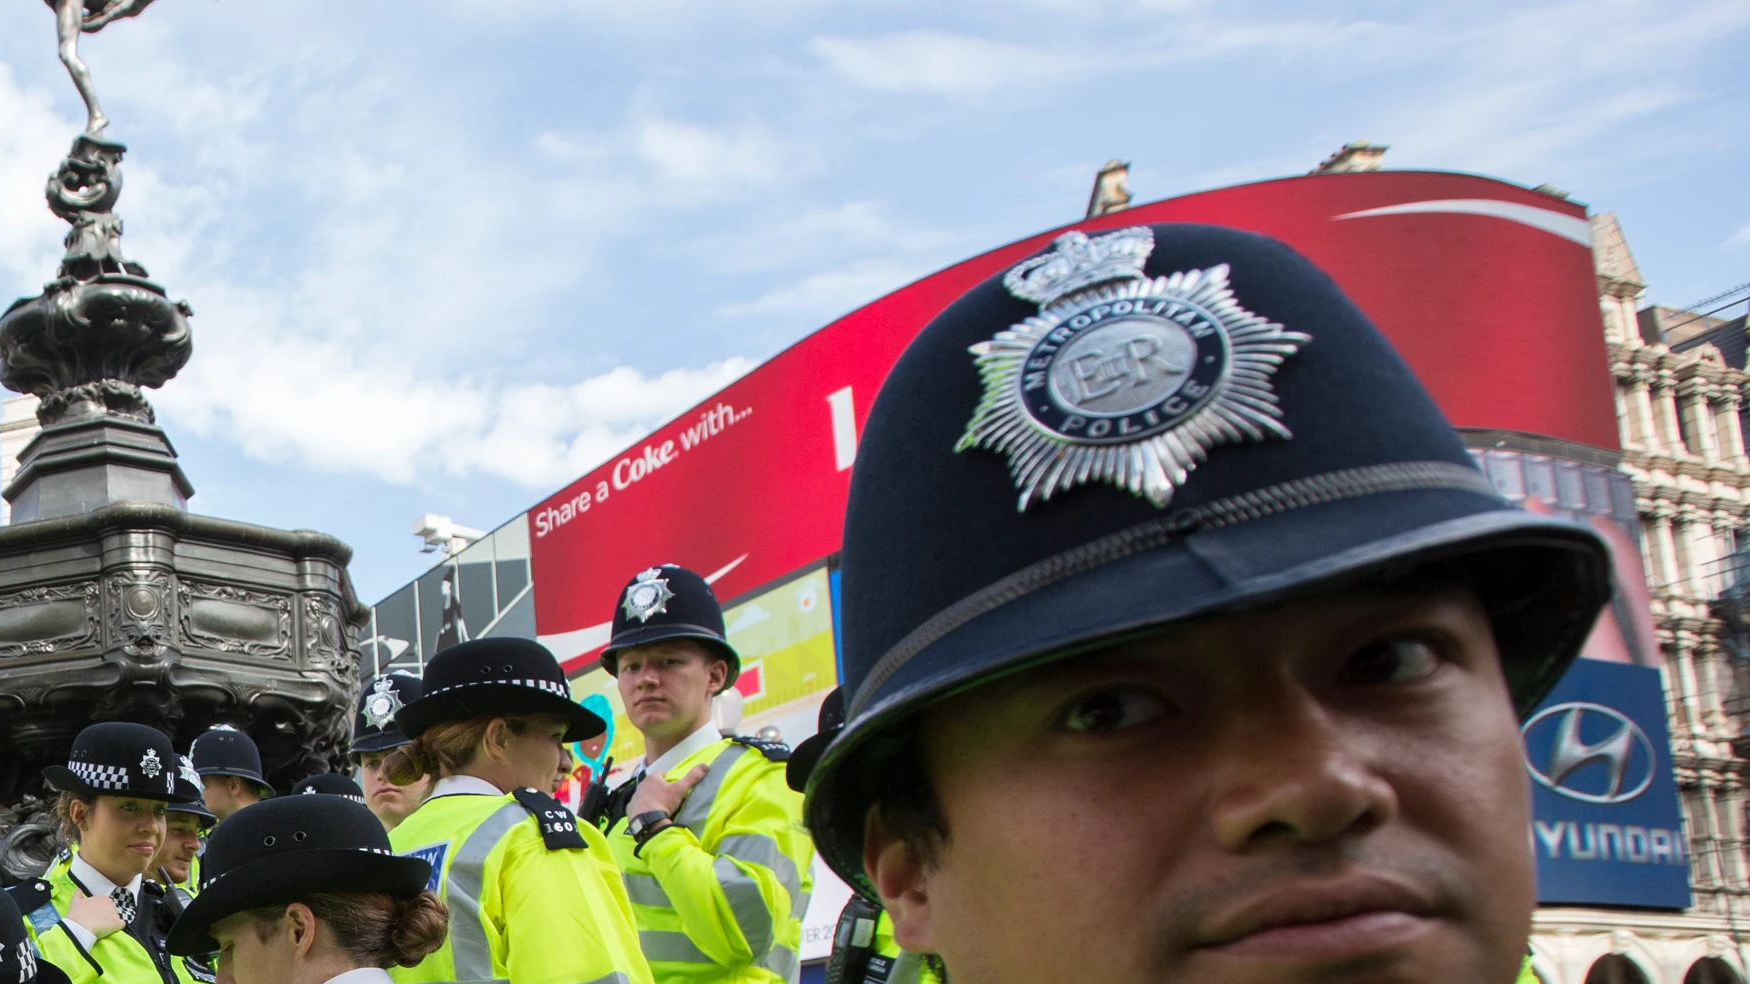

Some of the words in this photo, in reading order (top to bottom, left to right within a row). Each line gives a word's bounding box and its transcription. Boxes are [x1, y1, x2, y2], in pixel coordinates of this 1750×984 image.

[1023, 299, 1216, 391] METROPOLITAN
[1058, 379, 1210, 438] POLICE
[535, 491, 591, 537] Share
[595, 480, 610, 503] a
[679, 402, 753, 451] with...
